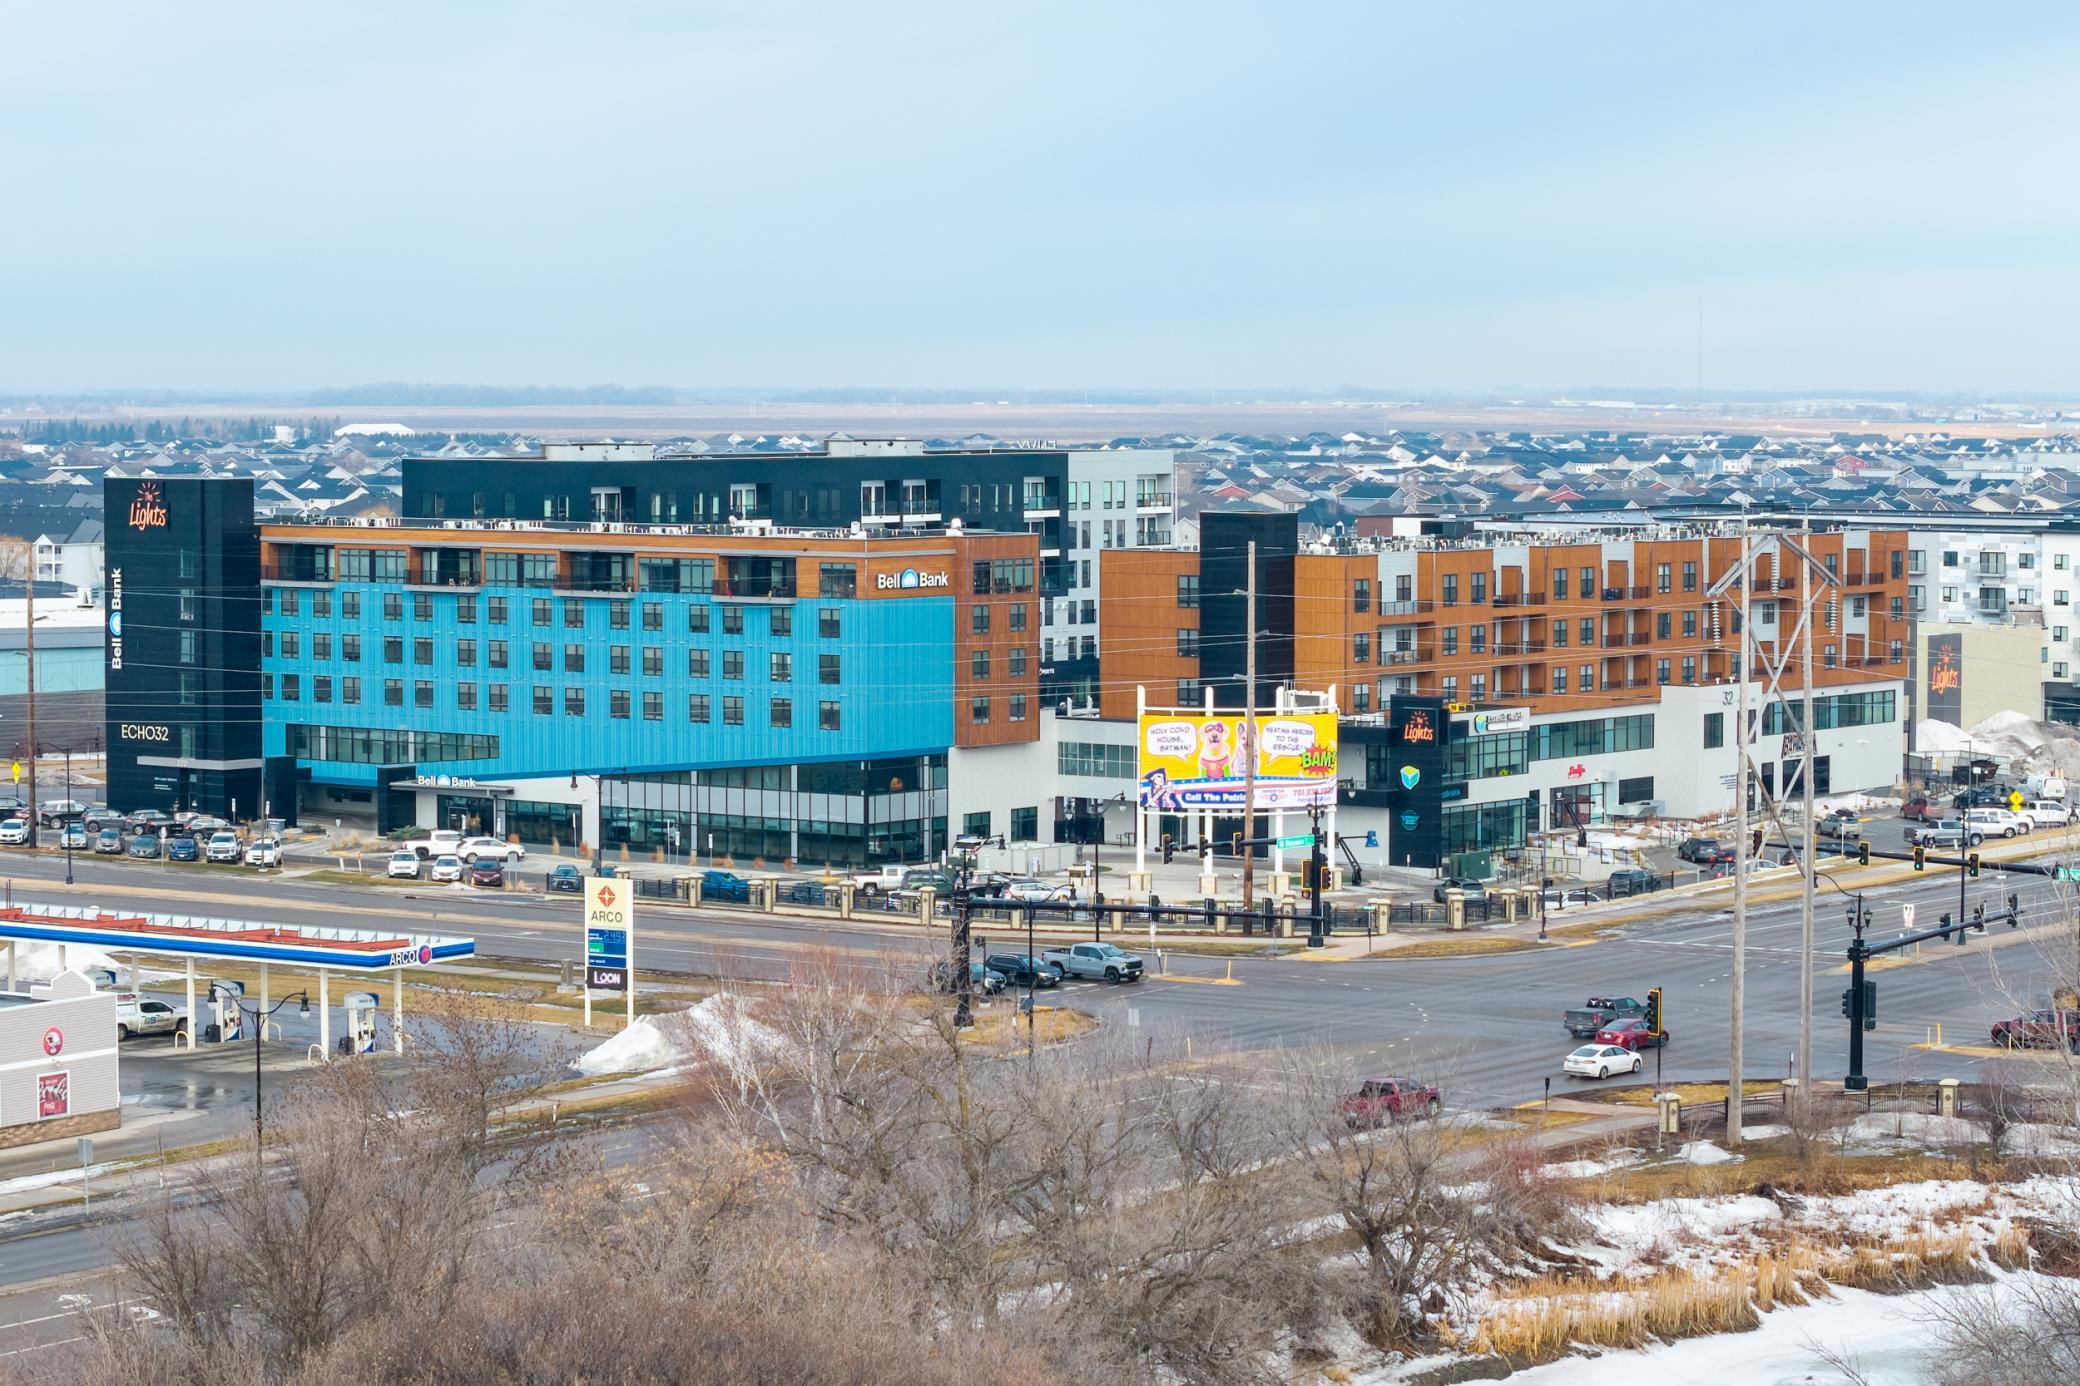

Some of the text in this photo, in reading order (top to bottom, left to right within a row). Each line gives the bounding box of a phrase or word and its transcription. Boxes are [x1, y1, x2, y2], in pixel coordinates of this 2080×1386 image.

[129, 501, 167, 531] Lights
[878, 571, 949, 589] Bell Bank
[111, 568, 122, 669] Bell Bank
[1932, 665, 1958, 694] Lights
[1722, 691, 1734, 706] 32
[121, 724, 169, 741] ECHO32
[1403, 723, 1434, 743] Lights
[1160, 744, 1192, 752] BATMAN!
[1302, 751, 1336, 769] BAM!
[417, 775, 476, 788] Bell Bank
[1185, 793, 1202, 801] Call
[1203, 793, 1220, 801] The
[591, 910, 623, 923] ARCO
[389, 950, 416, 966] ARCO
[594, 970, 621, 985] LOON
